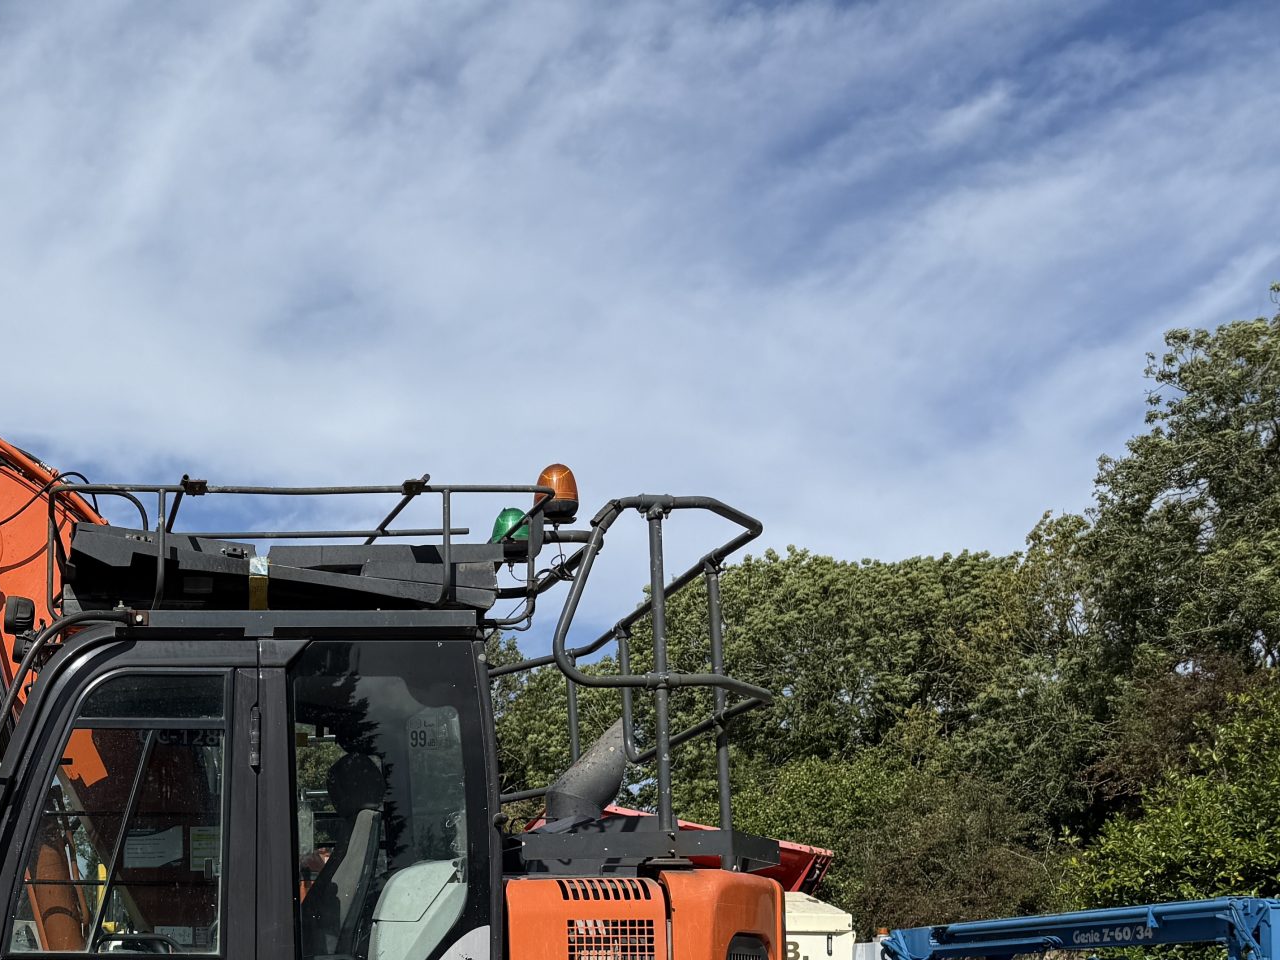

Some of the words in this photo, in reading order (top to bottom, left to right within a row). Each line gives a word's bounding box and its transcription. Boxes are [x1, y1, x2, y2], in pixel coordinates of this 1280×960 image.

[410, 730, 427, 748] 99
[1072, 929, 1100, 944] Genie
[1102, 925, 1154, 941] Z-60/34
